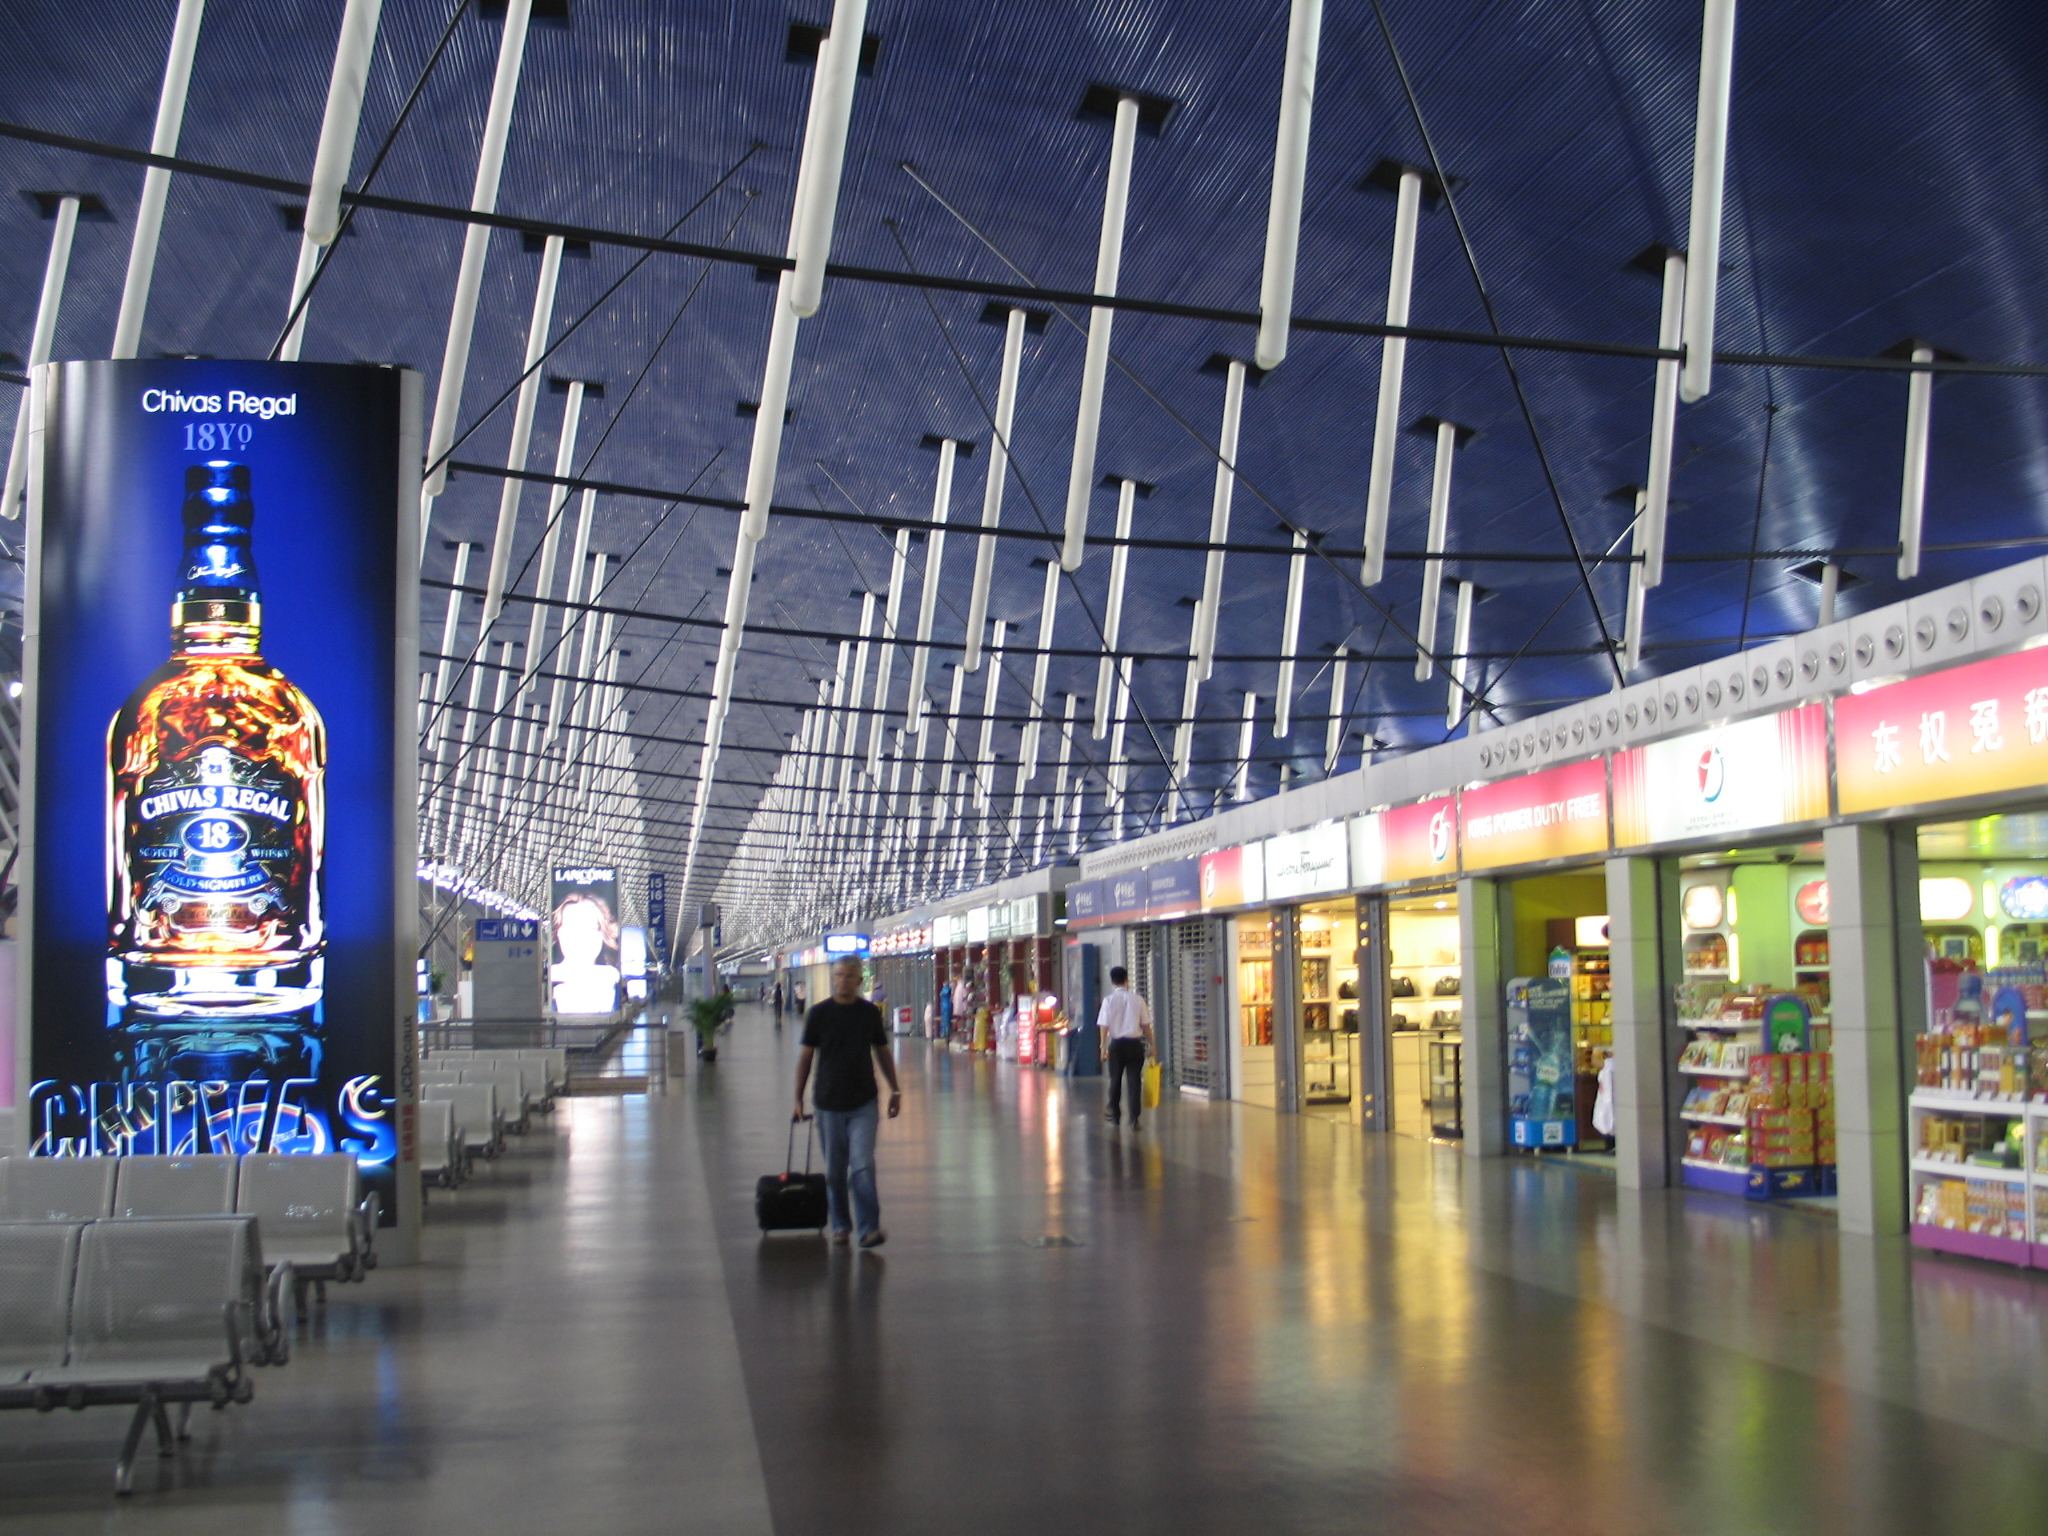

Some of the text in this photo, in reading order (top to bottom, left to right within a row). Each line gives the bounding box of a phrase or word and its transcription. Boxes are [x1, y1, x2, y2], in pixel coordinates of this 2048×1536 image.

[142, 389, 297, 420] Chivas Regal
[140, 786, 291, 822] CHIVAS REGAL
[1493, 807, 1533, 836] POWER
[1533, 800, 1565, 828] DUTY
[1566, 792, 1600, 821] FREE
[200, 821, 231, 848] 18
[139, 848, 291, 859] SCOTCH WHISKY
[198, 872, 264, 891] SIGNATURE
[651, 878, 663, 889] 15
[400, 1015, 413, 1098] JCDecaux
